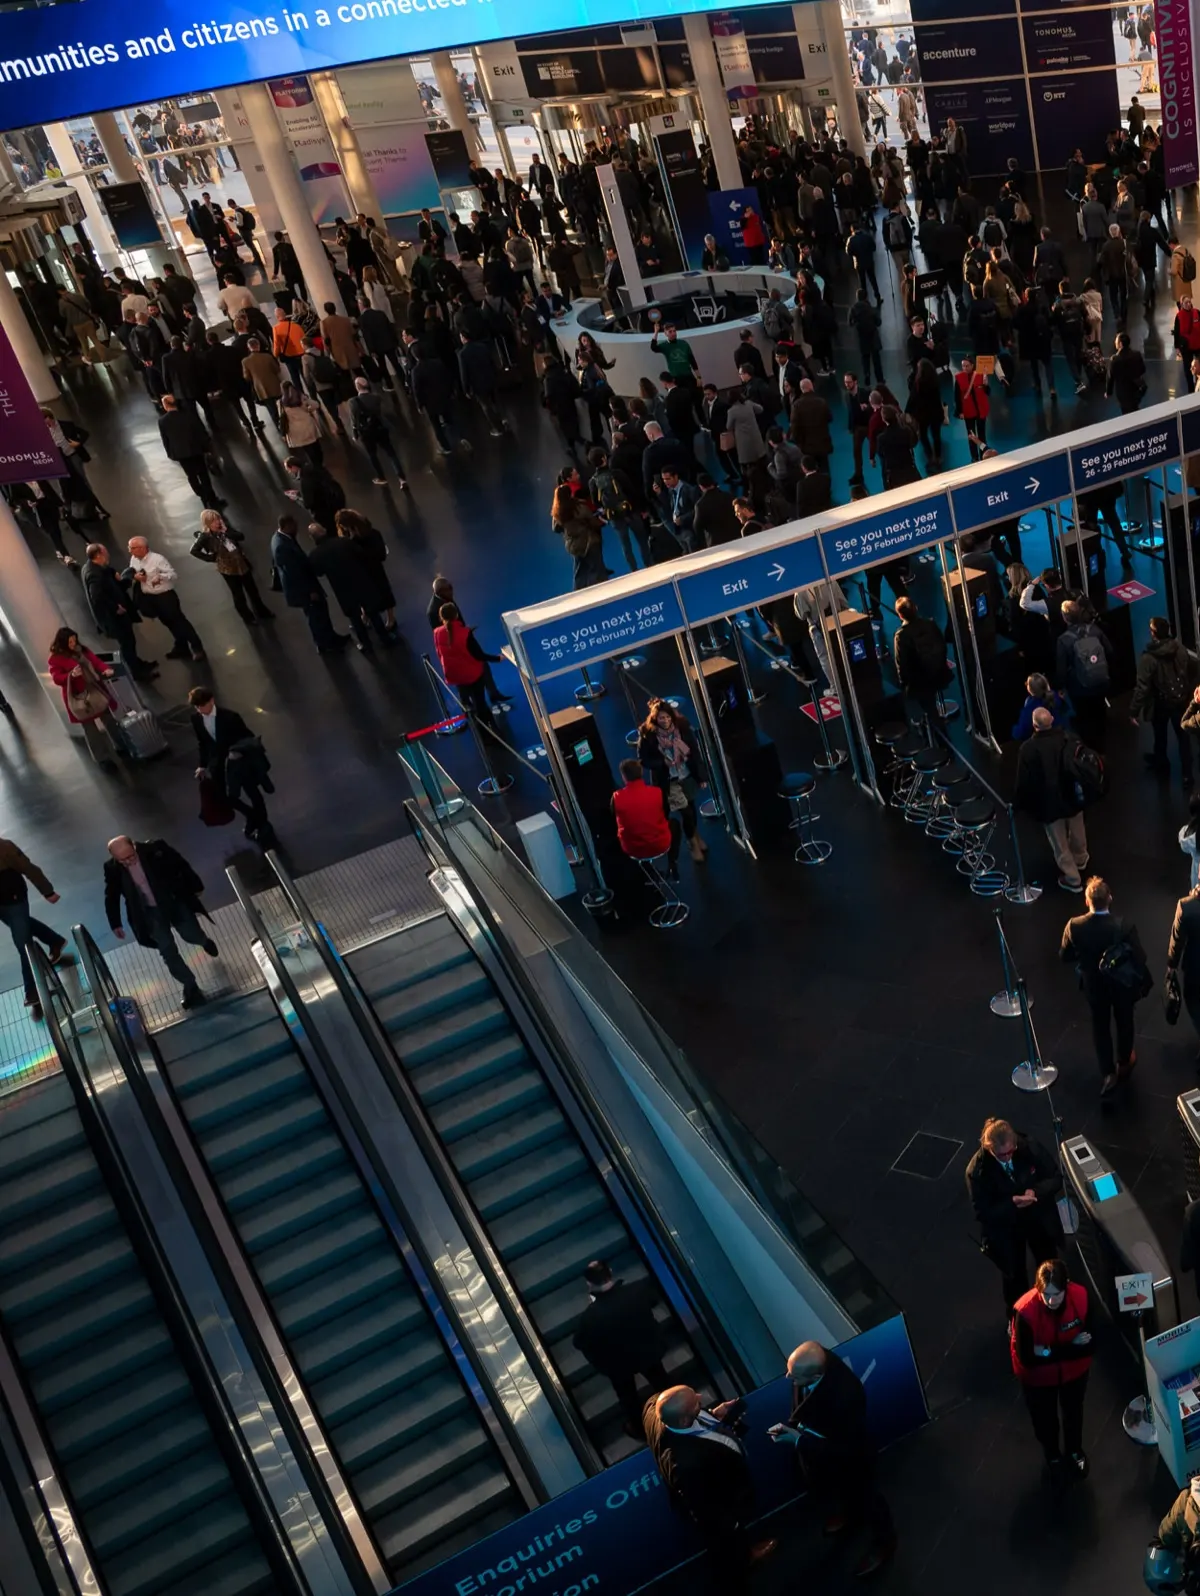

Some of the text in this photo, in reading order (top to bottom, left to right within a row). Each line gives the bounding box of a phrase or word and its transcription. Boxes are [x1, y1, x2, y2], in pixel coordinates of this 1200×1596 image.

[0, 42, 119, 82] munities
[125, 28, 176, 58] and
[181, 17, 278, 48] citizens
[283, 9, 309, 32] in
[316, 11, 331, 26] a
[808, 43, 828, 54] Exi
[1035, 27, 1075, 37] TONOMUS.
[493, 66, 515, 76] Exit
[923, 47, 977, 60] accenture
[1176, 3, 1194, 136] IS INCLUSIV
[0, 451, 50, 463] ONOMUS.
[1081, 431, 1169, 470] See you next year
[1085, 470, 1096, 479] 26
[1102, 464, 1112, 473] 29
[1113, 452, 1147, 467] February
[1148, 443, 1168, 457] 2024
[987, 492, 1009, 506] Exit
[835, 509, 938, 552] See you next year
[841, 552, 853, 562] 26
[861, 545, 872, 555] 29
[874, 532, 913, 549] February
[915, 522, 938, 537] 2024
[722, 579, 749, 596] Exit
[540, 600, 664, 651] See you next year
[549, 649, 563, 661] 26
[573, 642, 587, 654] 29
[589, 624, 635, 647] February
[639, 614, 665, 629] 2024
[1121, 1279, 1148, 1291] EXIT
[455, 1470, 661, 1596] Enquiries Offi
